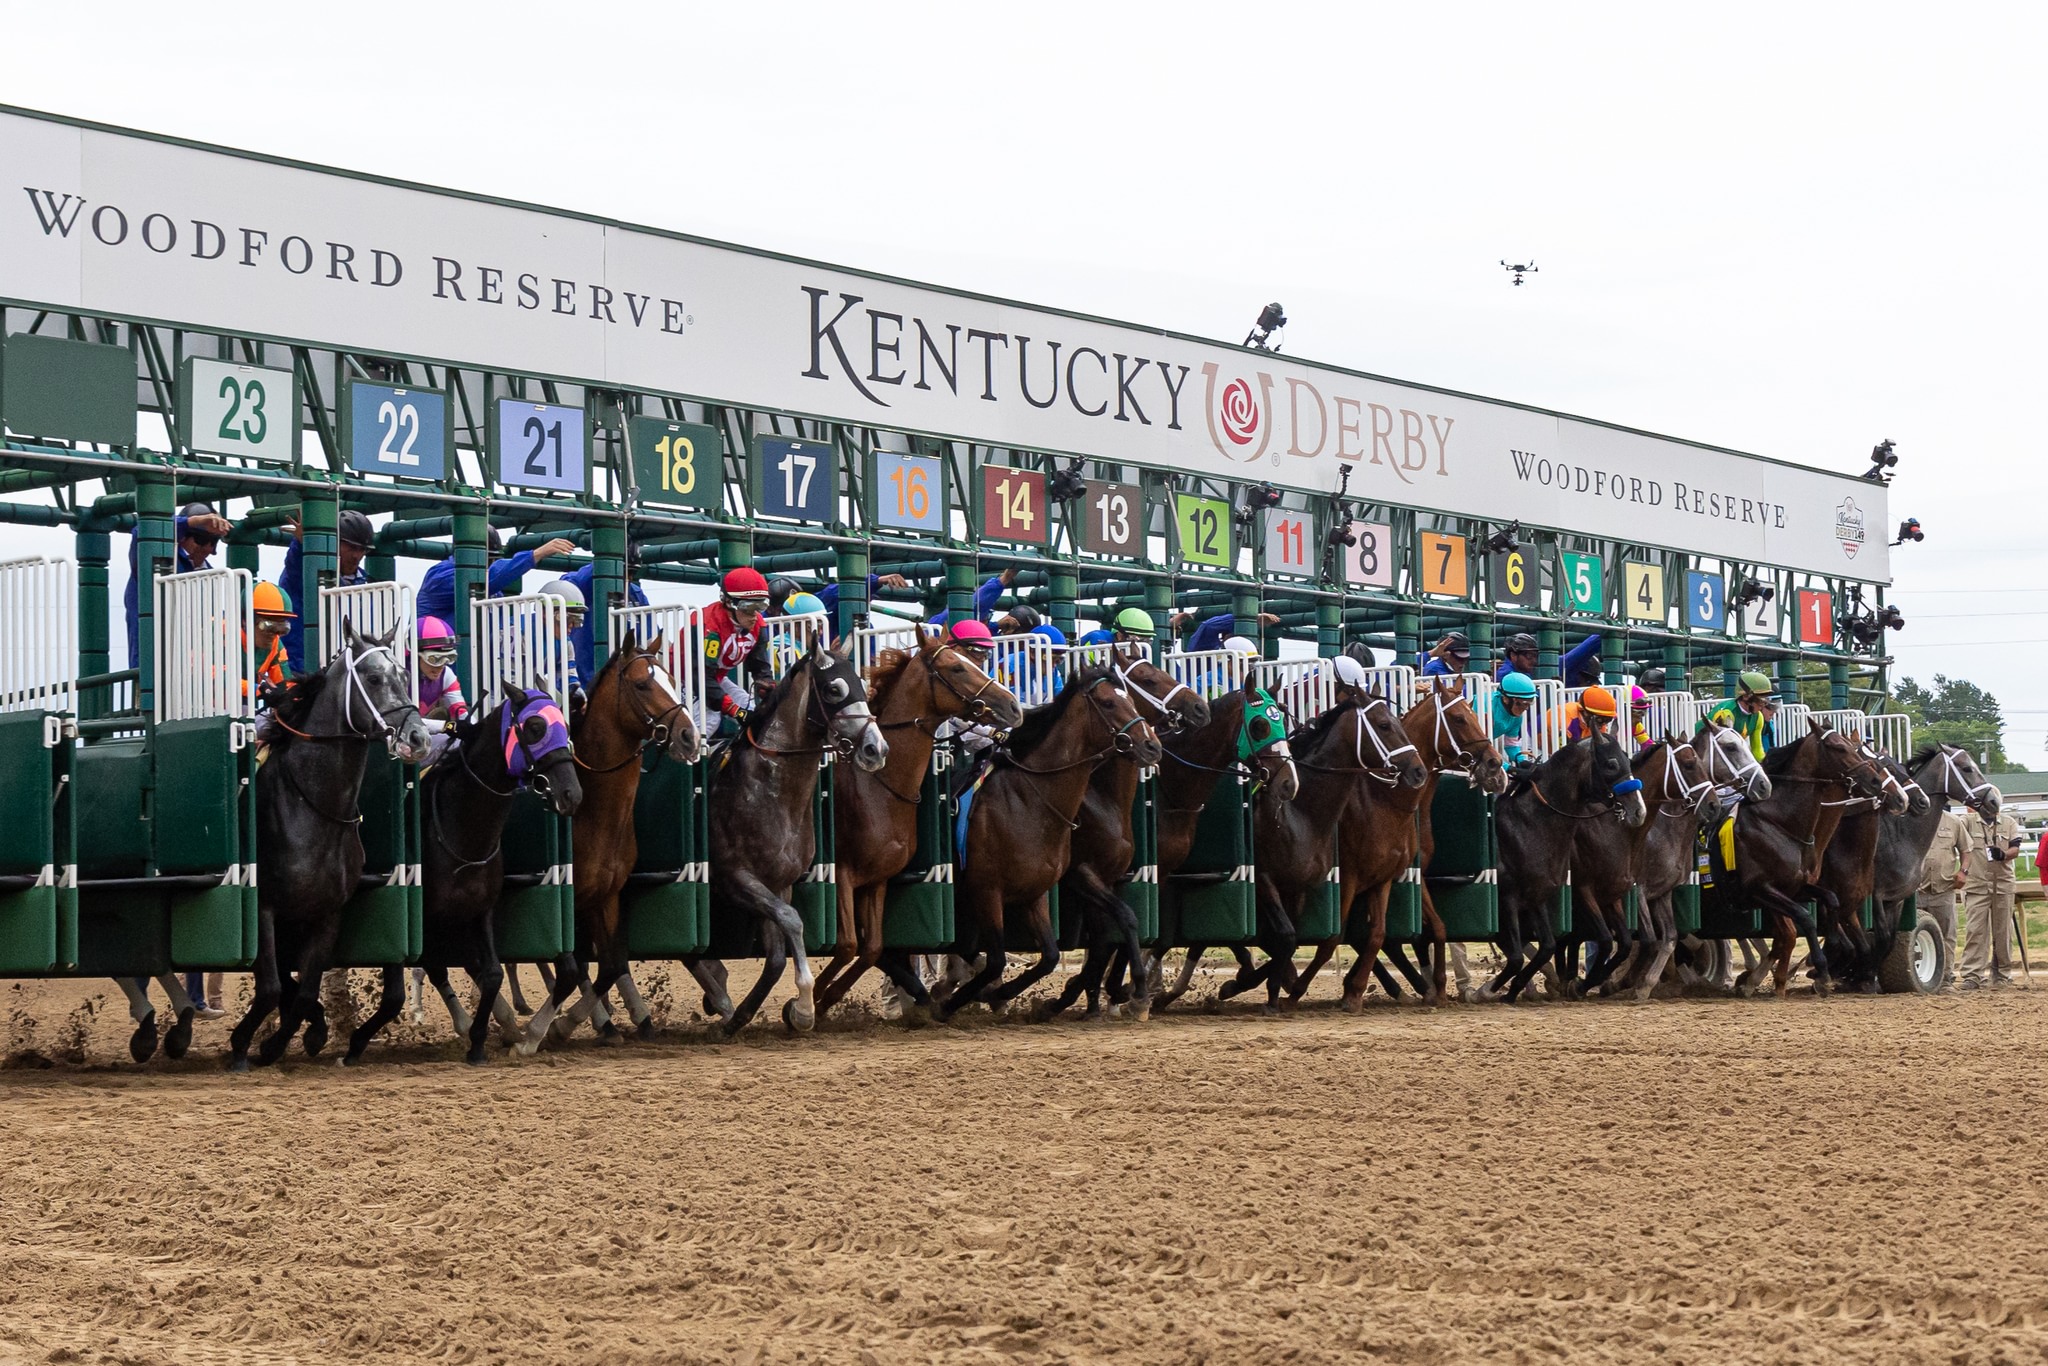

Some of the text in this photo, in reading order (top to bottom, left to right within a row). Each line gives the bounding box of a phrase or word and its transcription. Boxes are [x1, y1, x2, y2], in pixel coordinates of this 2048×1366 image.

[22, 186, 685, 336] WOODFORD RESERVE
[800, 285, 1191, 431] KENTUCKY
[219, 377, 266, 443] 23
[378, 401, 419, 465] 22
[1285, 377, 1455, 485] DERBY
[523, 416, 562, 477] 21
[655, 436, 694, 494] 18
[779, 454, 815, 508] 17
[891, 467, 929, 519] 16
[995, 478, 1034, 531] 14
[1509, 449, 1786, 530] WOODFORD RESERVE
[1096, 494, 1130, 544] 13
[1190, 508, 1219, 556] 12
[1276, 519, 1303, 565] 11
[1838, 511, 1861, 526] Kentucky
[1359, 531, 1378, 576] 8
[1436, 543, 1452, 585] 7
[1506, 552, 1525, 596] 6
[1575, 562, 1591, 603] 5
[1637, 573, 1652, 612] 4
[1699, 581, 1714, 621] 3
[1811, 599, 1821, 635] 1
